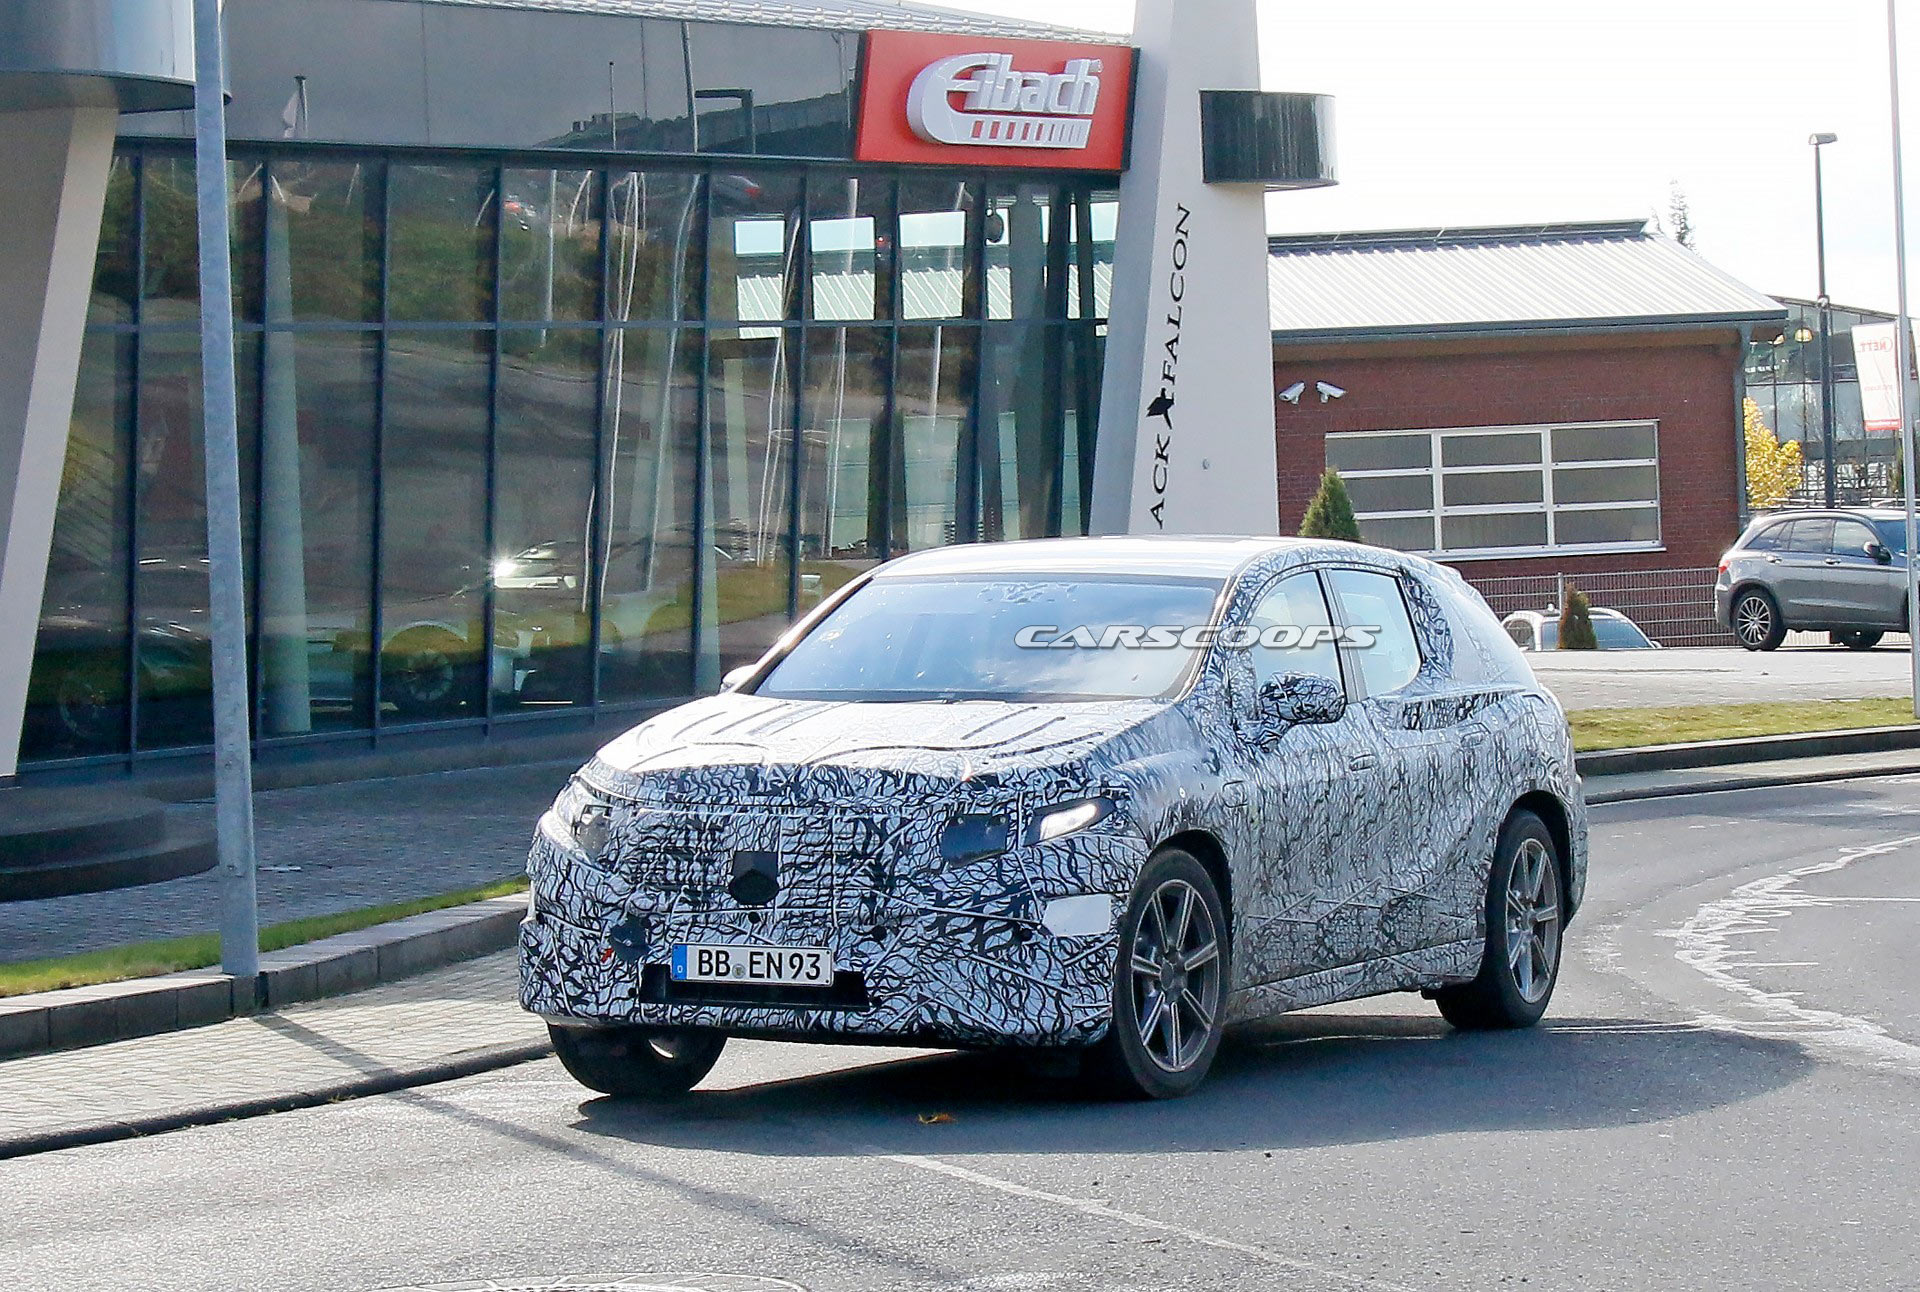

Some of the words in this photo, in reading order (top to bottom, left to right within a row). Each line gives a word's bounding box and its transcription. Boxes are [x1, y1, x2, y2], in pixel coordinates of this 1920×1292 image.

[907, 52, 1103, 148] Eibach
[1150, 433, 1171, 530] ACK
[1162, 203, 1191, 386] FALCON
[699, 949, 731, 976] BB
[750, 951, 783, 979] EN
[789, 953, 821, 980] 93
